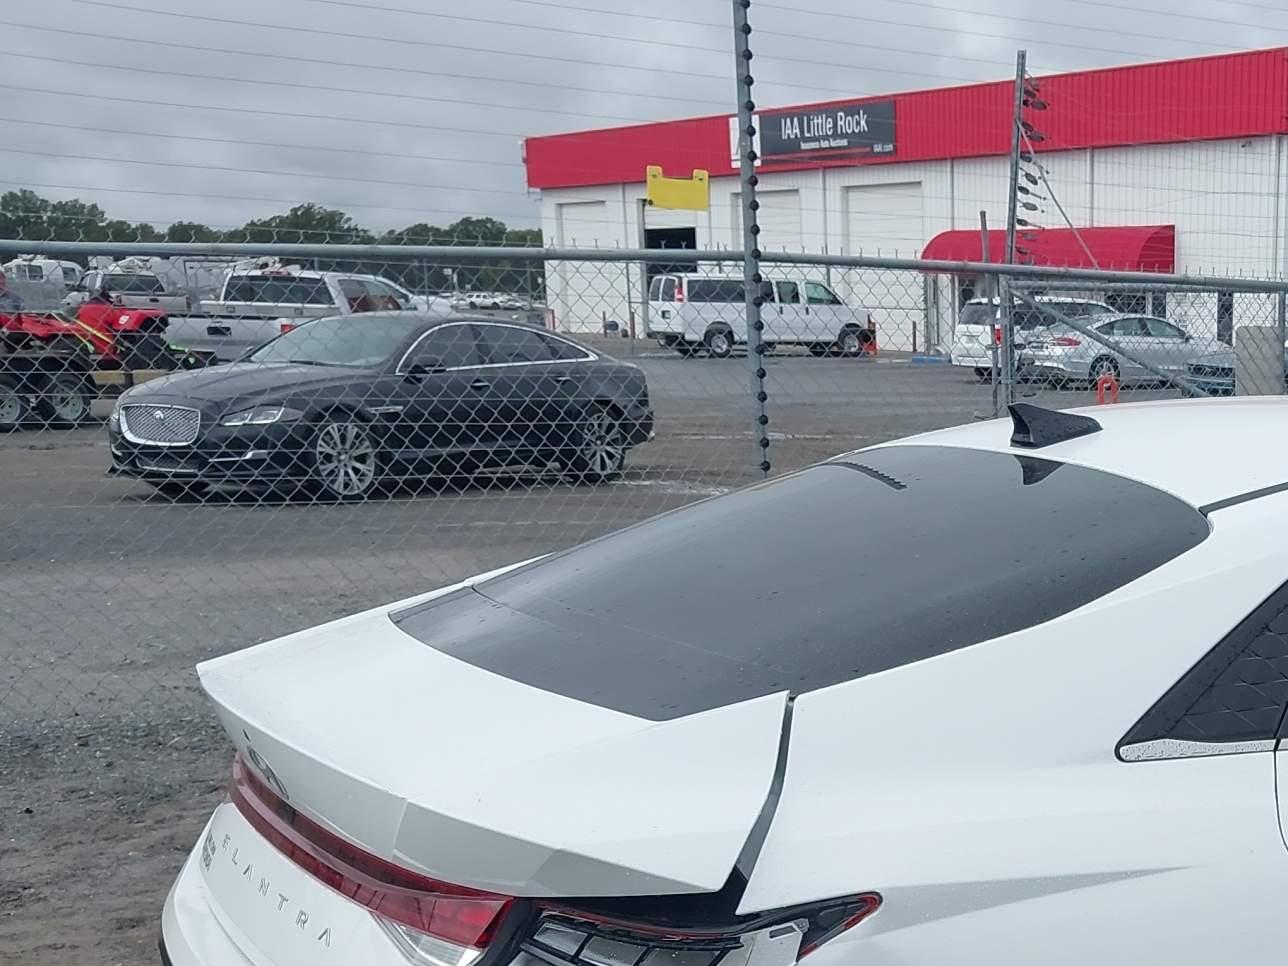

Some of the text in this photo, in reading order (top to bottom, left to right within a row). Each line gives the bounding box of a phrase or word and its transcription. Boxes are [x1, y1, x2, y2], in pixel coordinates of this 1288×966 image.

[781, 109, 868, 140] IAA Little Rock
[222, 833, 332, 947] ELANTRA
